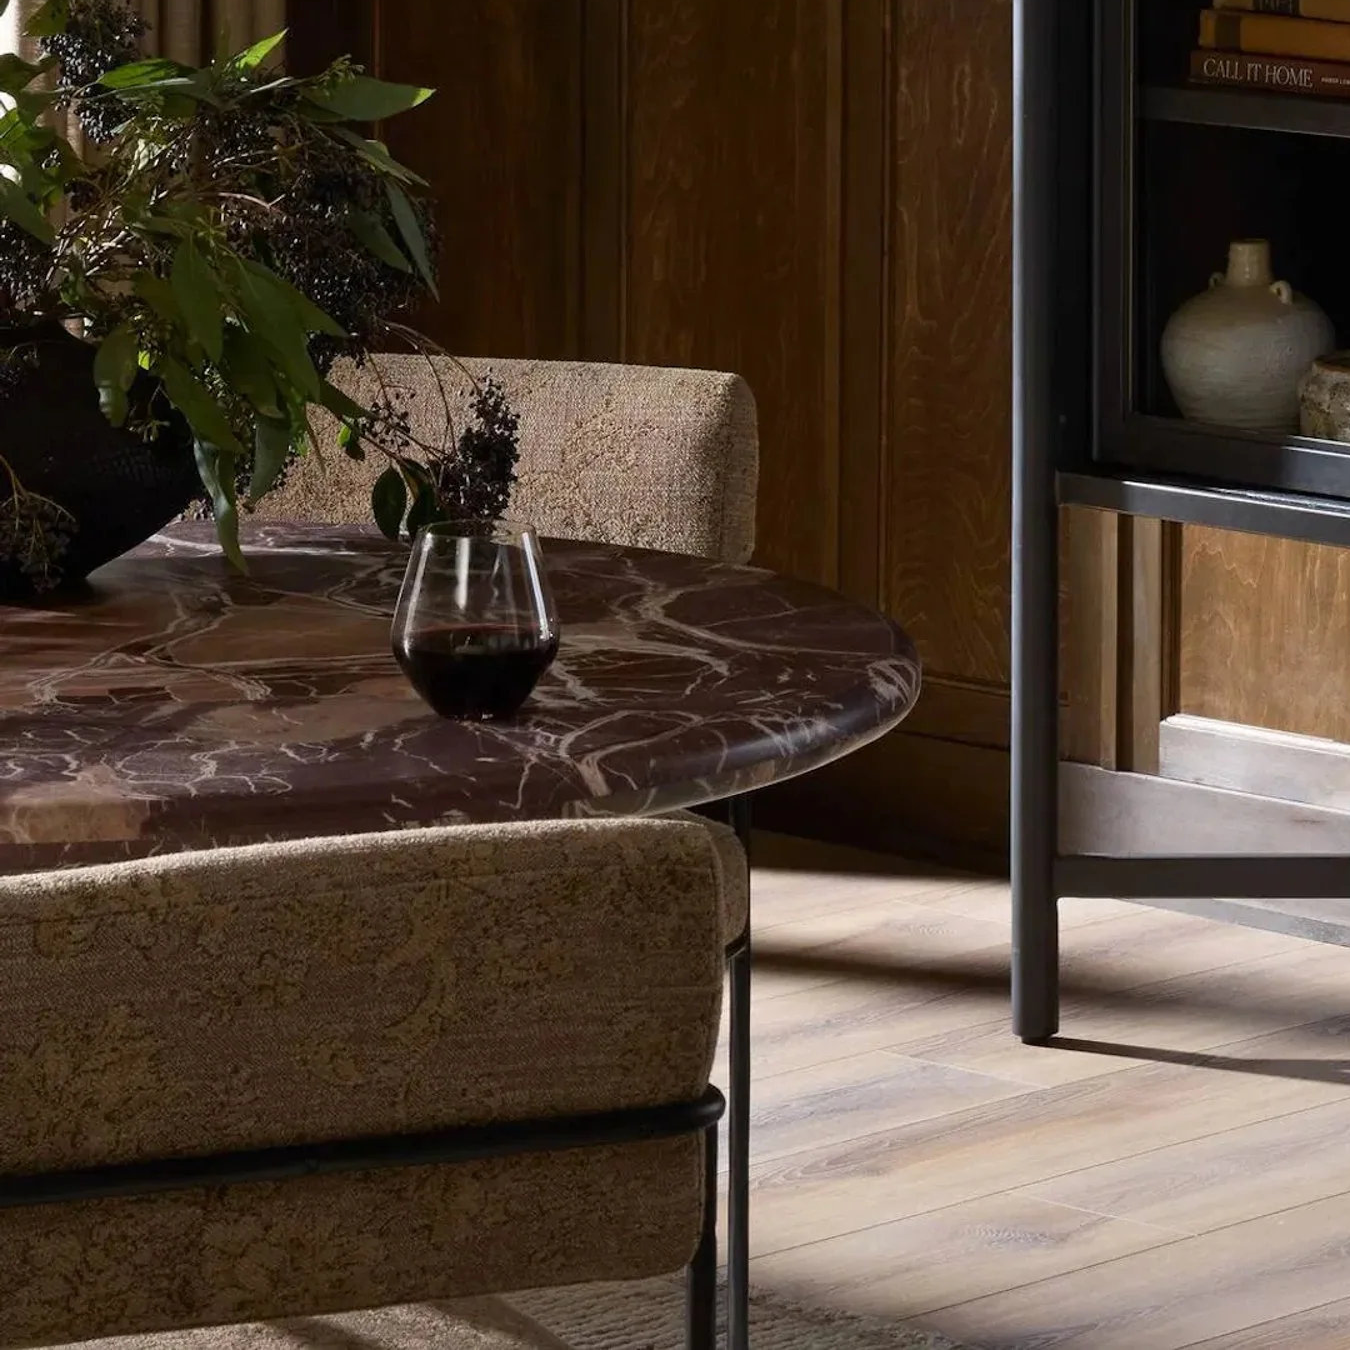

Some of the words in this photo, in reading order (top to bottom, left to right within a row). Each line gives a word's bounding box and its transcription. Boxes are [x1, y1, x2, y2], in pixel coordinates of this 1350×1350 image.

[1203, 58, 1243, 80] CALL
[1246, 63, 1262, 82] IT
[1265, 64, 1314, 88] HOME
